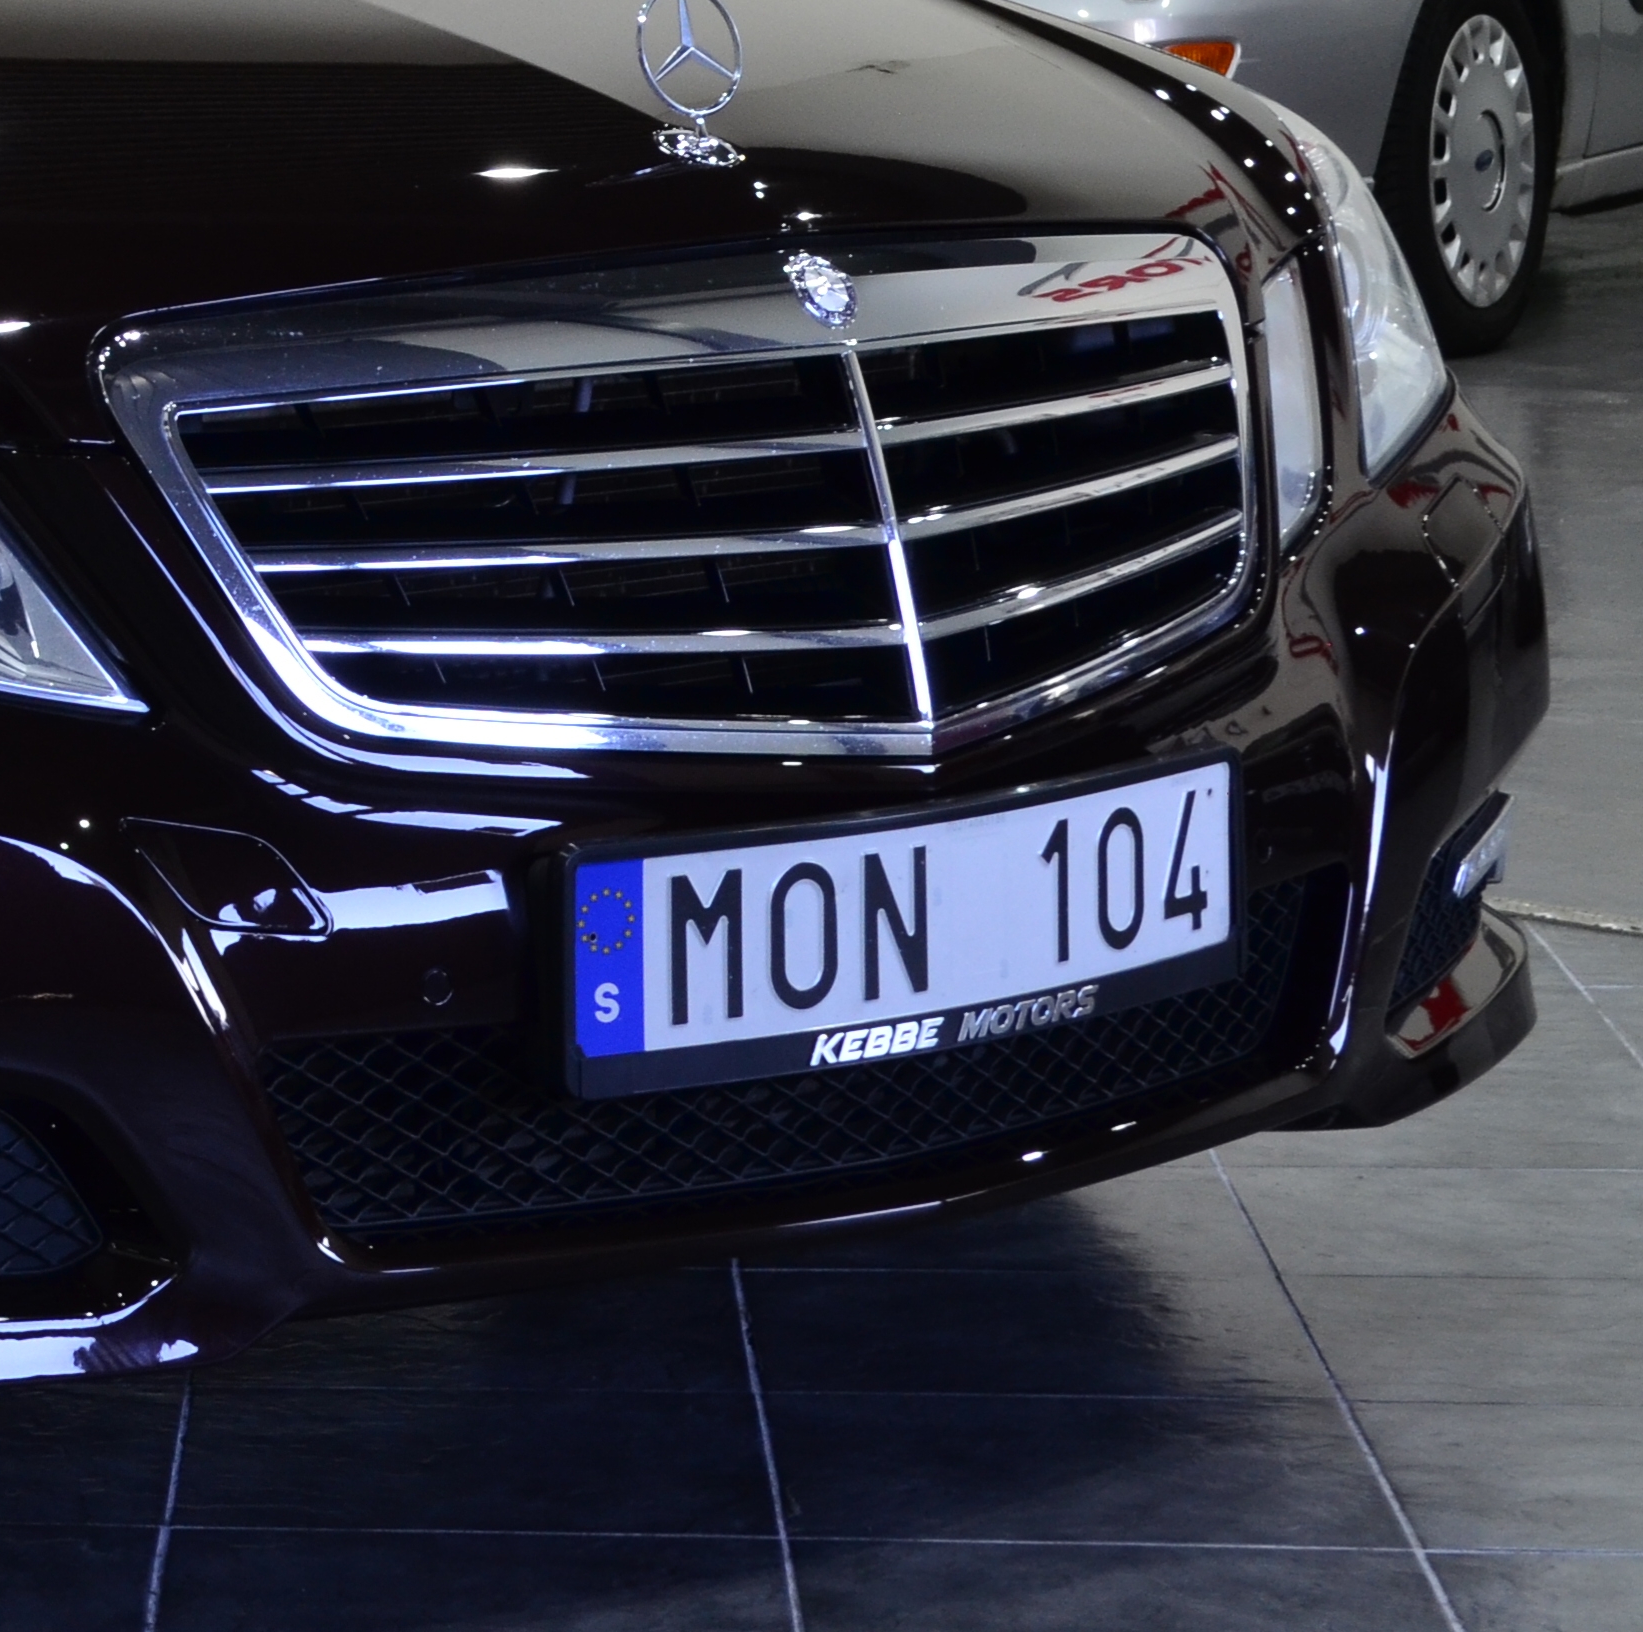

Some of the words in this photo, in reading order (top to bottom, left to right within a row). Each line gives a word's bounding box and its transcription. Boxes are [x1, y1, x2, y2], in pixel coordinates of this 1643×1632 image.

[668, 844, 930, 1026] MON
[1038, 789, 1209, 964] 104
[593, 981, 621, 1024] S
[809, 1016, 945, 1068] KEBBE
[956, 984, 1101, 1043] MOTORS
